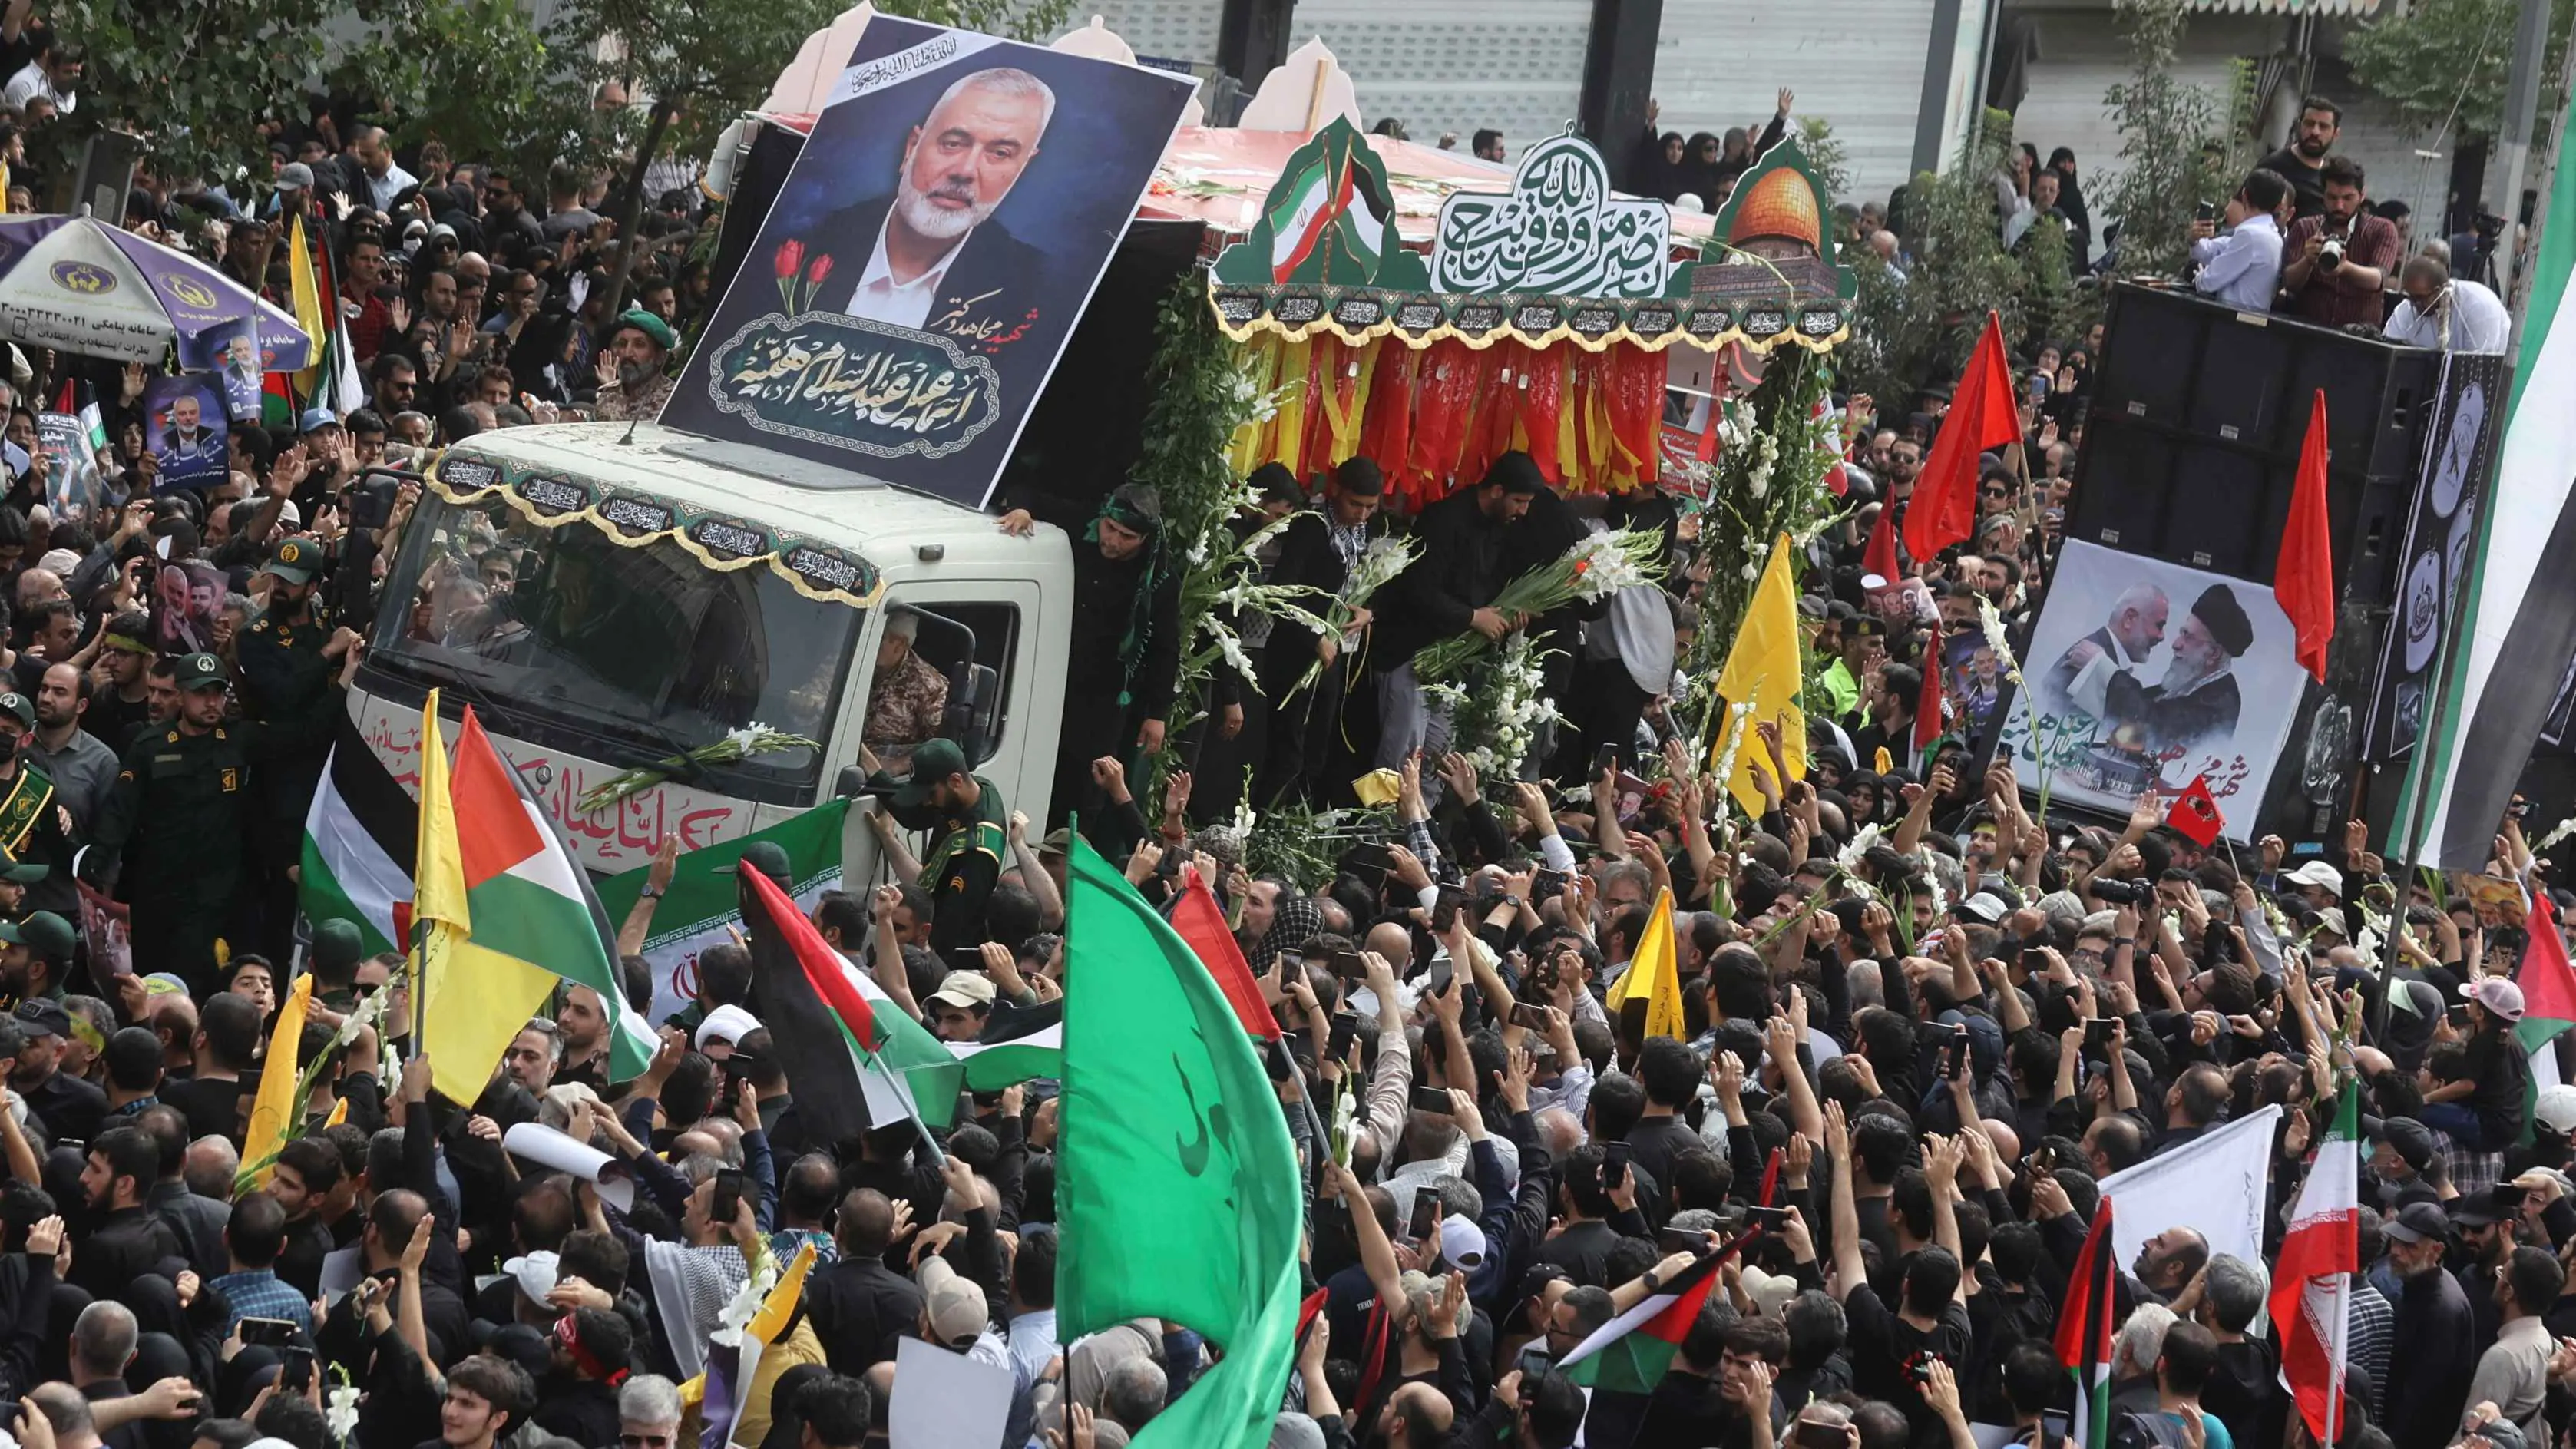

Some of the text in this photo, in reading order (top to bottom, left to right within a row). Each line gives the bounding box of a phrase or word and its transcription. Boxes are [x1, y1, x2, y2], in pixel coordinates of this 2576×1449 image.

[985, 308, 1038, 353] شهید
[730, 334, 811, 398] هنیه
[889, 364, 978, 434] اسماعیل
